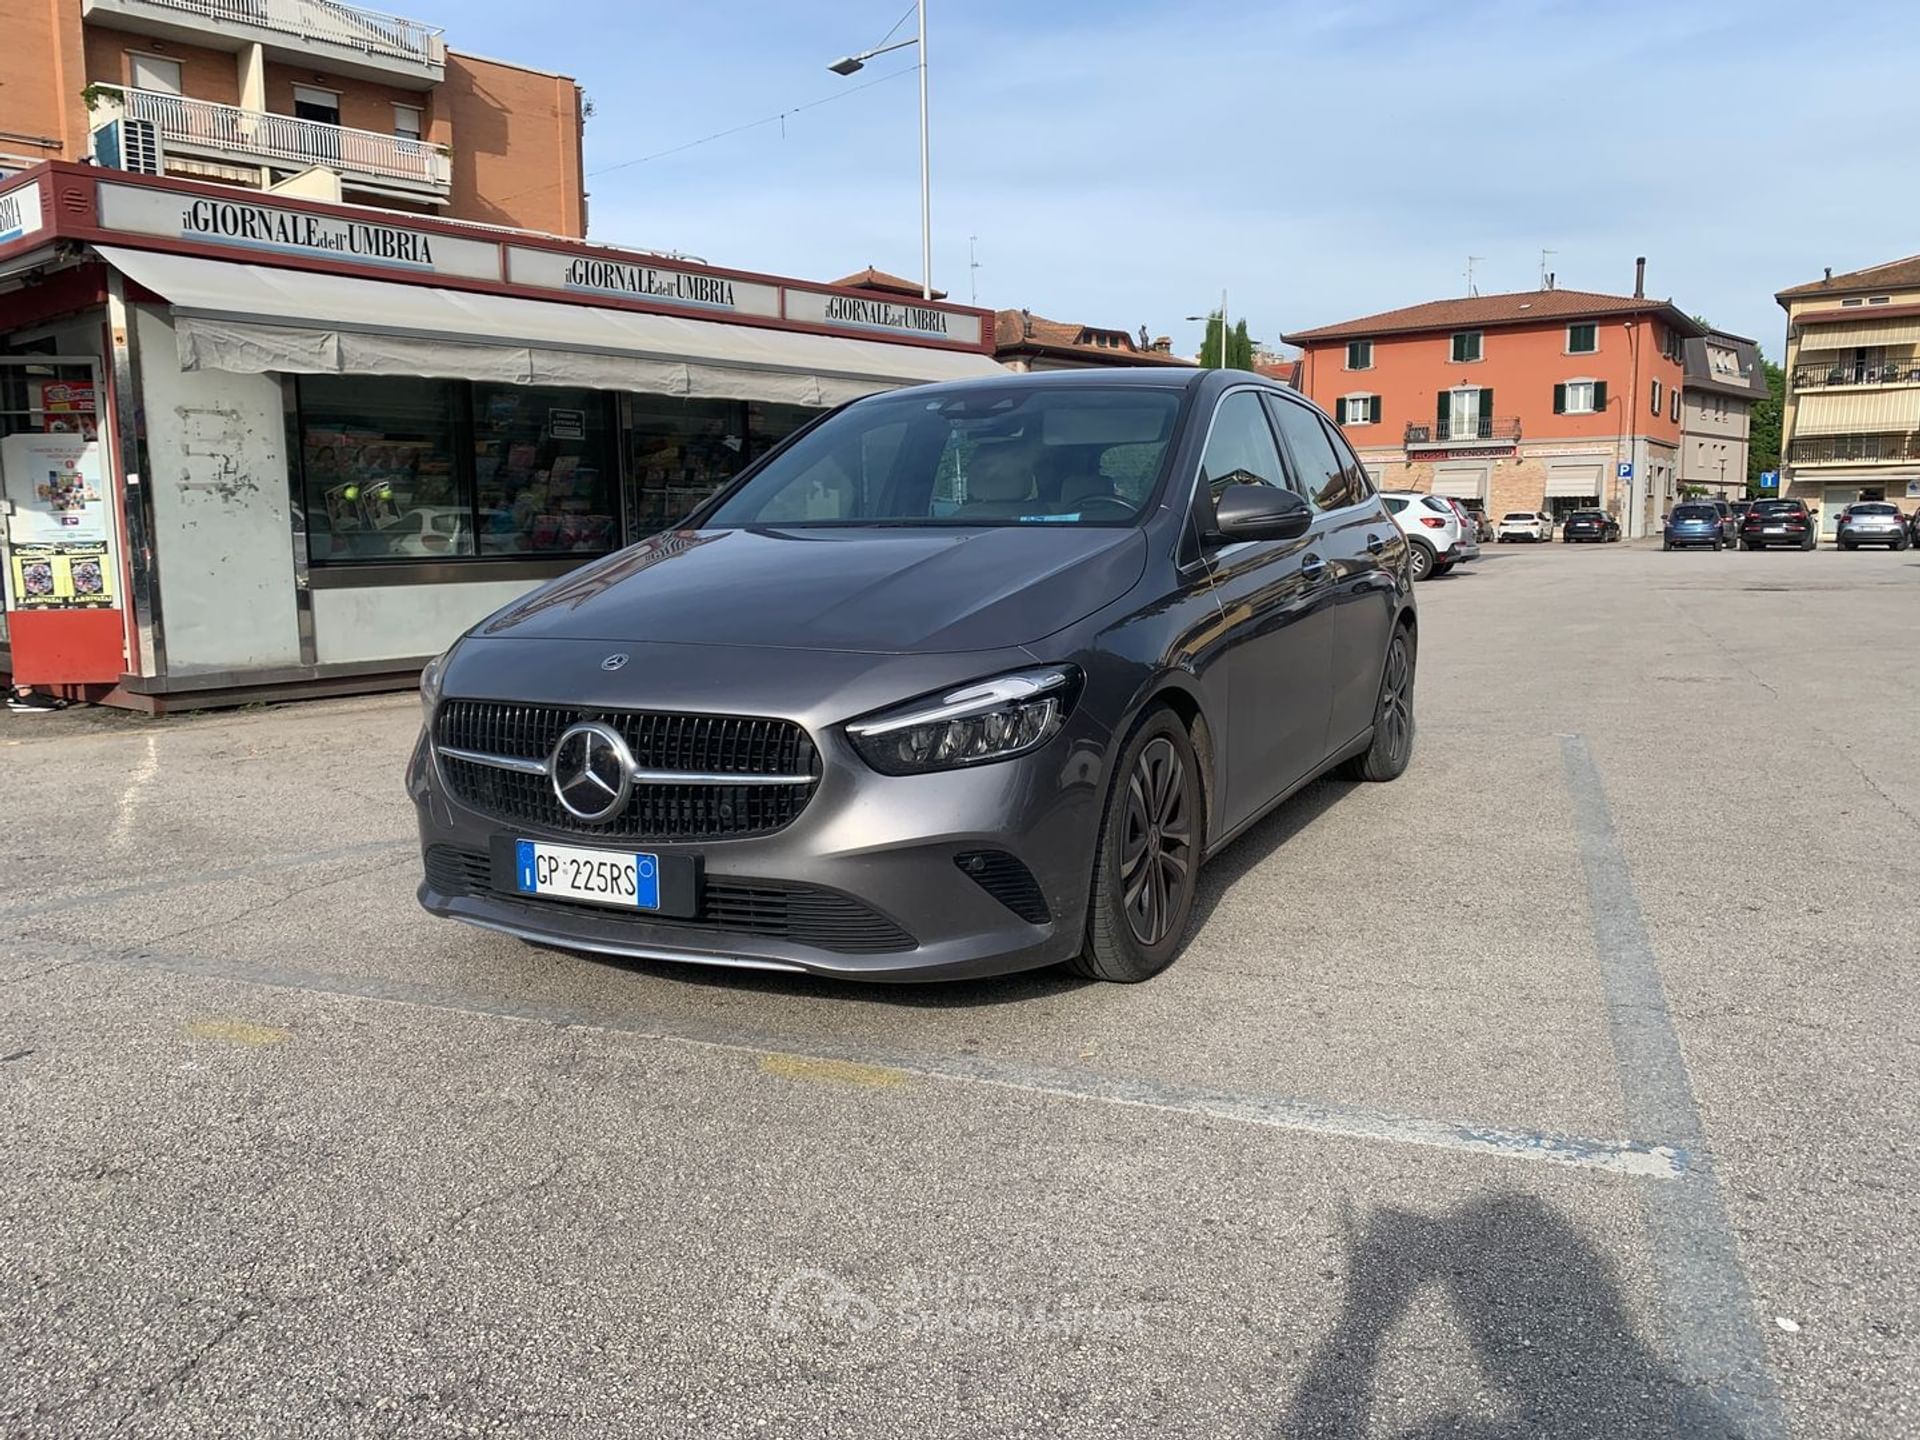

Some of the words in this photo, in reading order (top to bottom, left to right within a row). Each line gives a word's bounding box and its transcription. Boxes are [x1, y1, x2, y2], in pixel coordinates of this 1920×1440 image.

[1620, 464, 1630, 477] P
[536, 854, 559, 885] GP
[570, 858, 636, 896] 225RS
